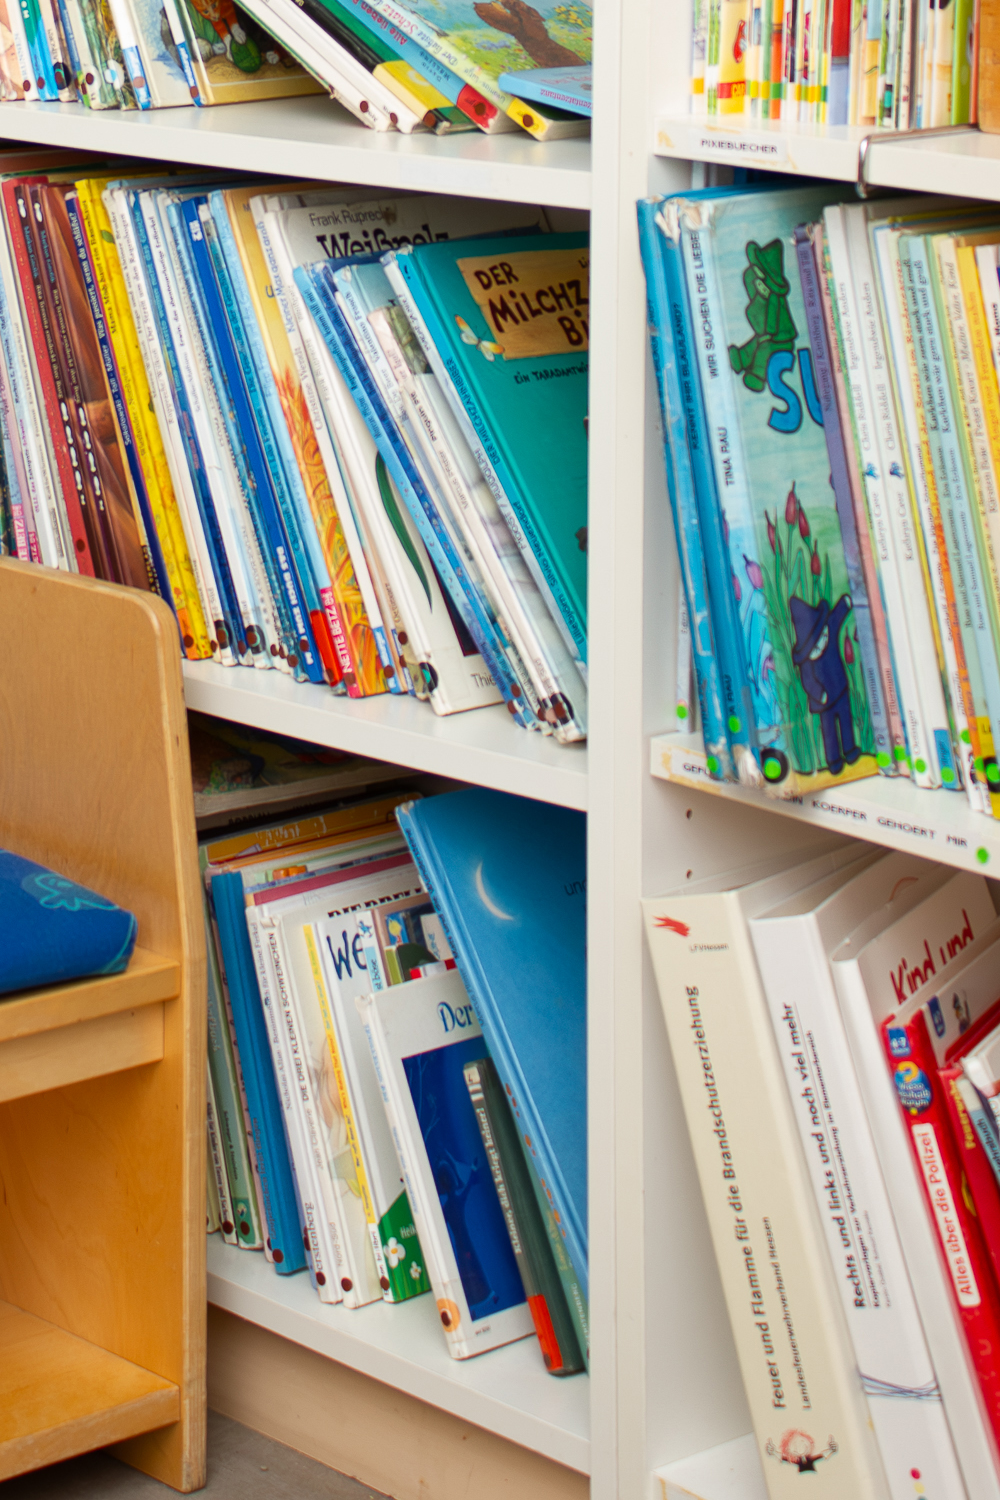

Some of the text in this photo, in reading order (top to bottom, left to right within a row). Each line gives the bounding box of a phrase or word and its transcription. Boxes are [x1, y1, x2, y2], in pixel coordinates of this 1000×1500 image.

[364, 4, 388, 28] lieben
[389, 26, 407, 45] Alle
[700, 138, 778, 154] PIXIEBUECHER
[309, 210, 342, 227] Frank
[474, 262, 519, 290] DER
[689, 231, 717, 376] WIR SUCHEN DIE LIEBE
[718, 427, 732, 485] TINA RAU
[812, 799, 968, 847] KOERPER GEHOERT MIR
[890, 907, 975, 1004] Kind und
[269, 933, 309, 1101] DIE DREI KLEINEN SCHWEINCHEN
[783, 1003, 865, 1307] Rechts und links und noch viel mehr
[686, 986, 785, 1408] Feuer und Flamme für die Brandschutzerziehung
[918, 1132, 971, 1294] Alles über die Polizei
